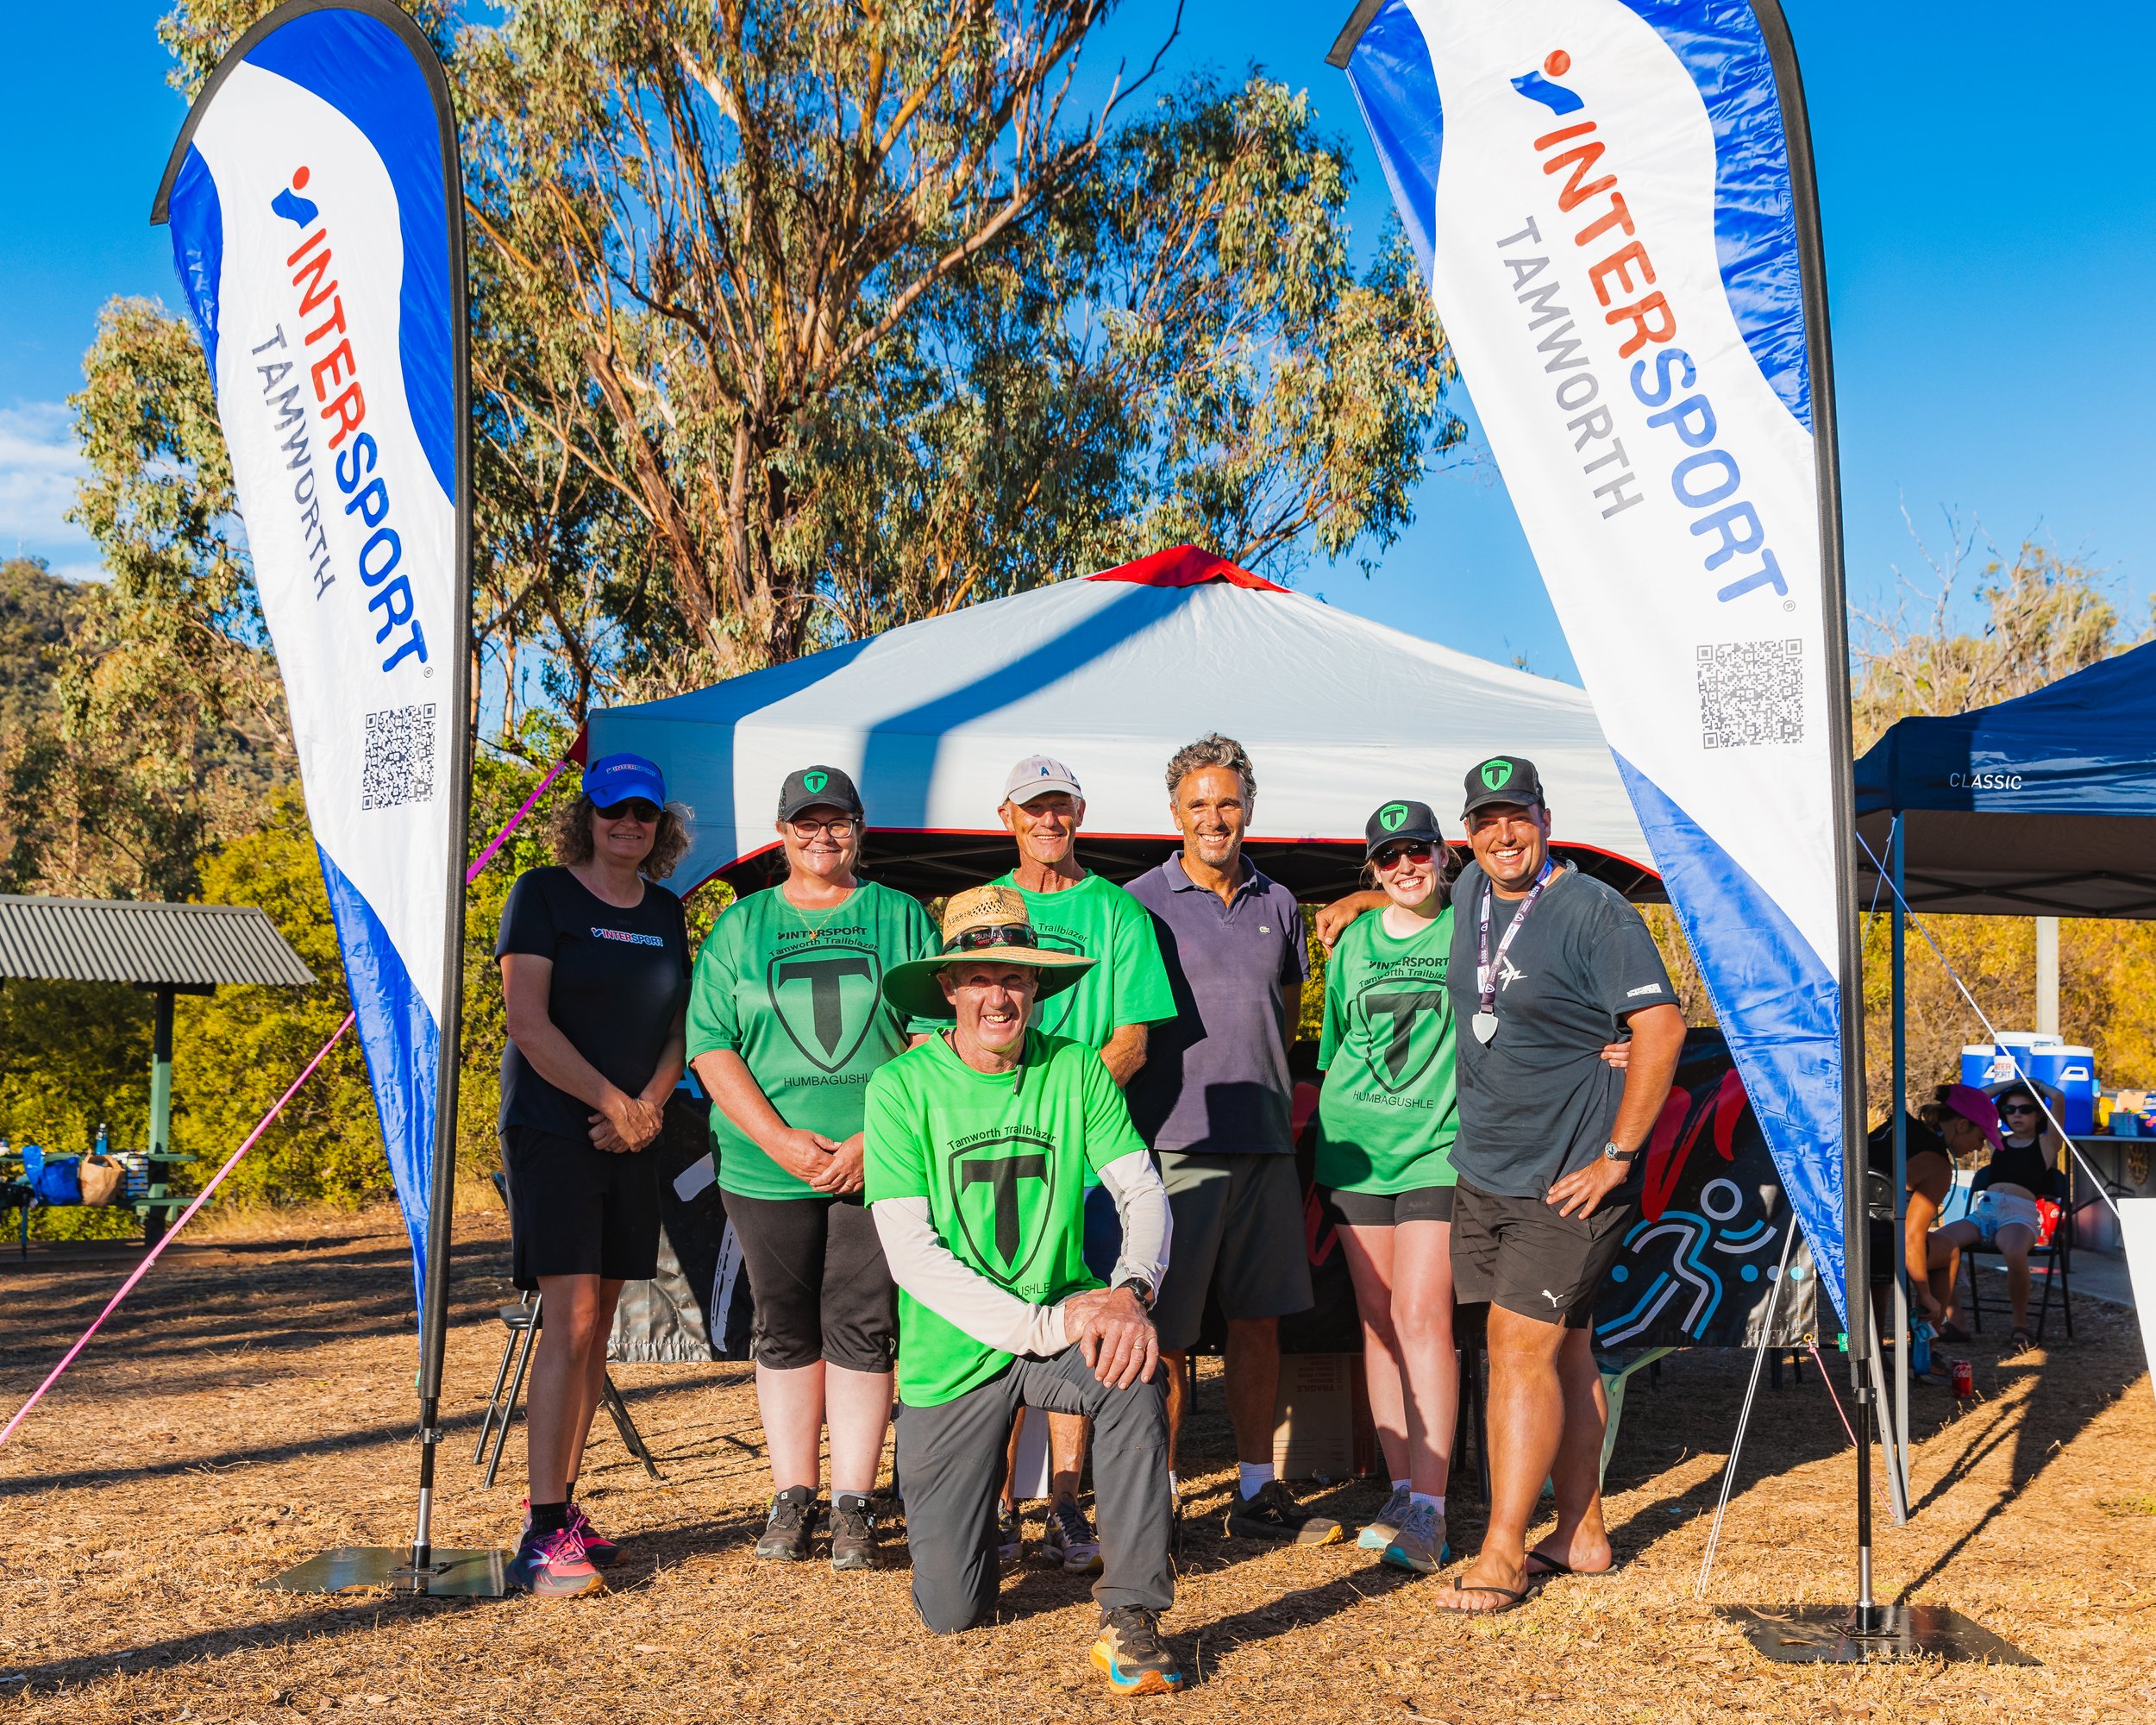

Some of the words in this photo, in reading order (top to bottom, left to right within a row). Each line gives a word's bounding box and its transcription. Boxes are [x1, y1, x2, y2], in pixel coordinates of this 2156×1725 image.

[1496, 216, 1645, 520] TAMWORTH
[1534, 121, 1789, 603] INTERSPORT
[287, 228, 429, 673] INTERSPORT
[252, 323, 335, 601] TAMWORTH
[1041, 766, 1050, 776] A
[1950, 773, 2022, 790] CLASSIC
[602, 929, 664, 947] INTERSPORT
[1038, 923, 1087, 942] Trailblazer
[768, 938, 821, 957] Tamworth
[824, 937, 880, 950] Trailblazer
[1408, 968, 1446, 981] Trailblaz
[784, 1072, 870, 1088] HUMBAGUSHL
[1353, 1090, 1435, 1109] HUMBAGUSHLE
[947, 1127, 1001, 1151] Tamworth
[1005, 1125, 1056, 1143] Trailblazer
[1297, 1384, 1333, 1393] FRAGILE
